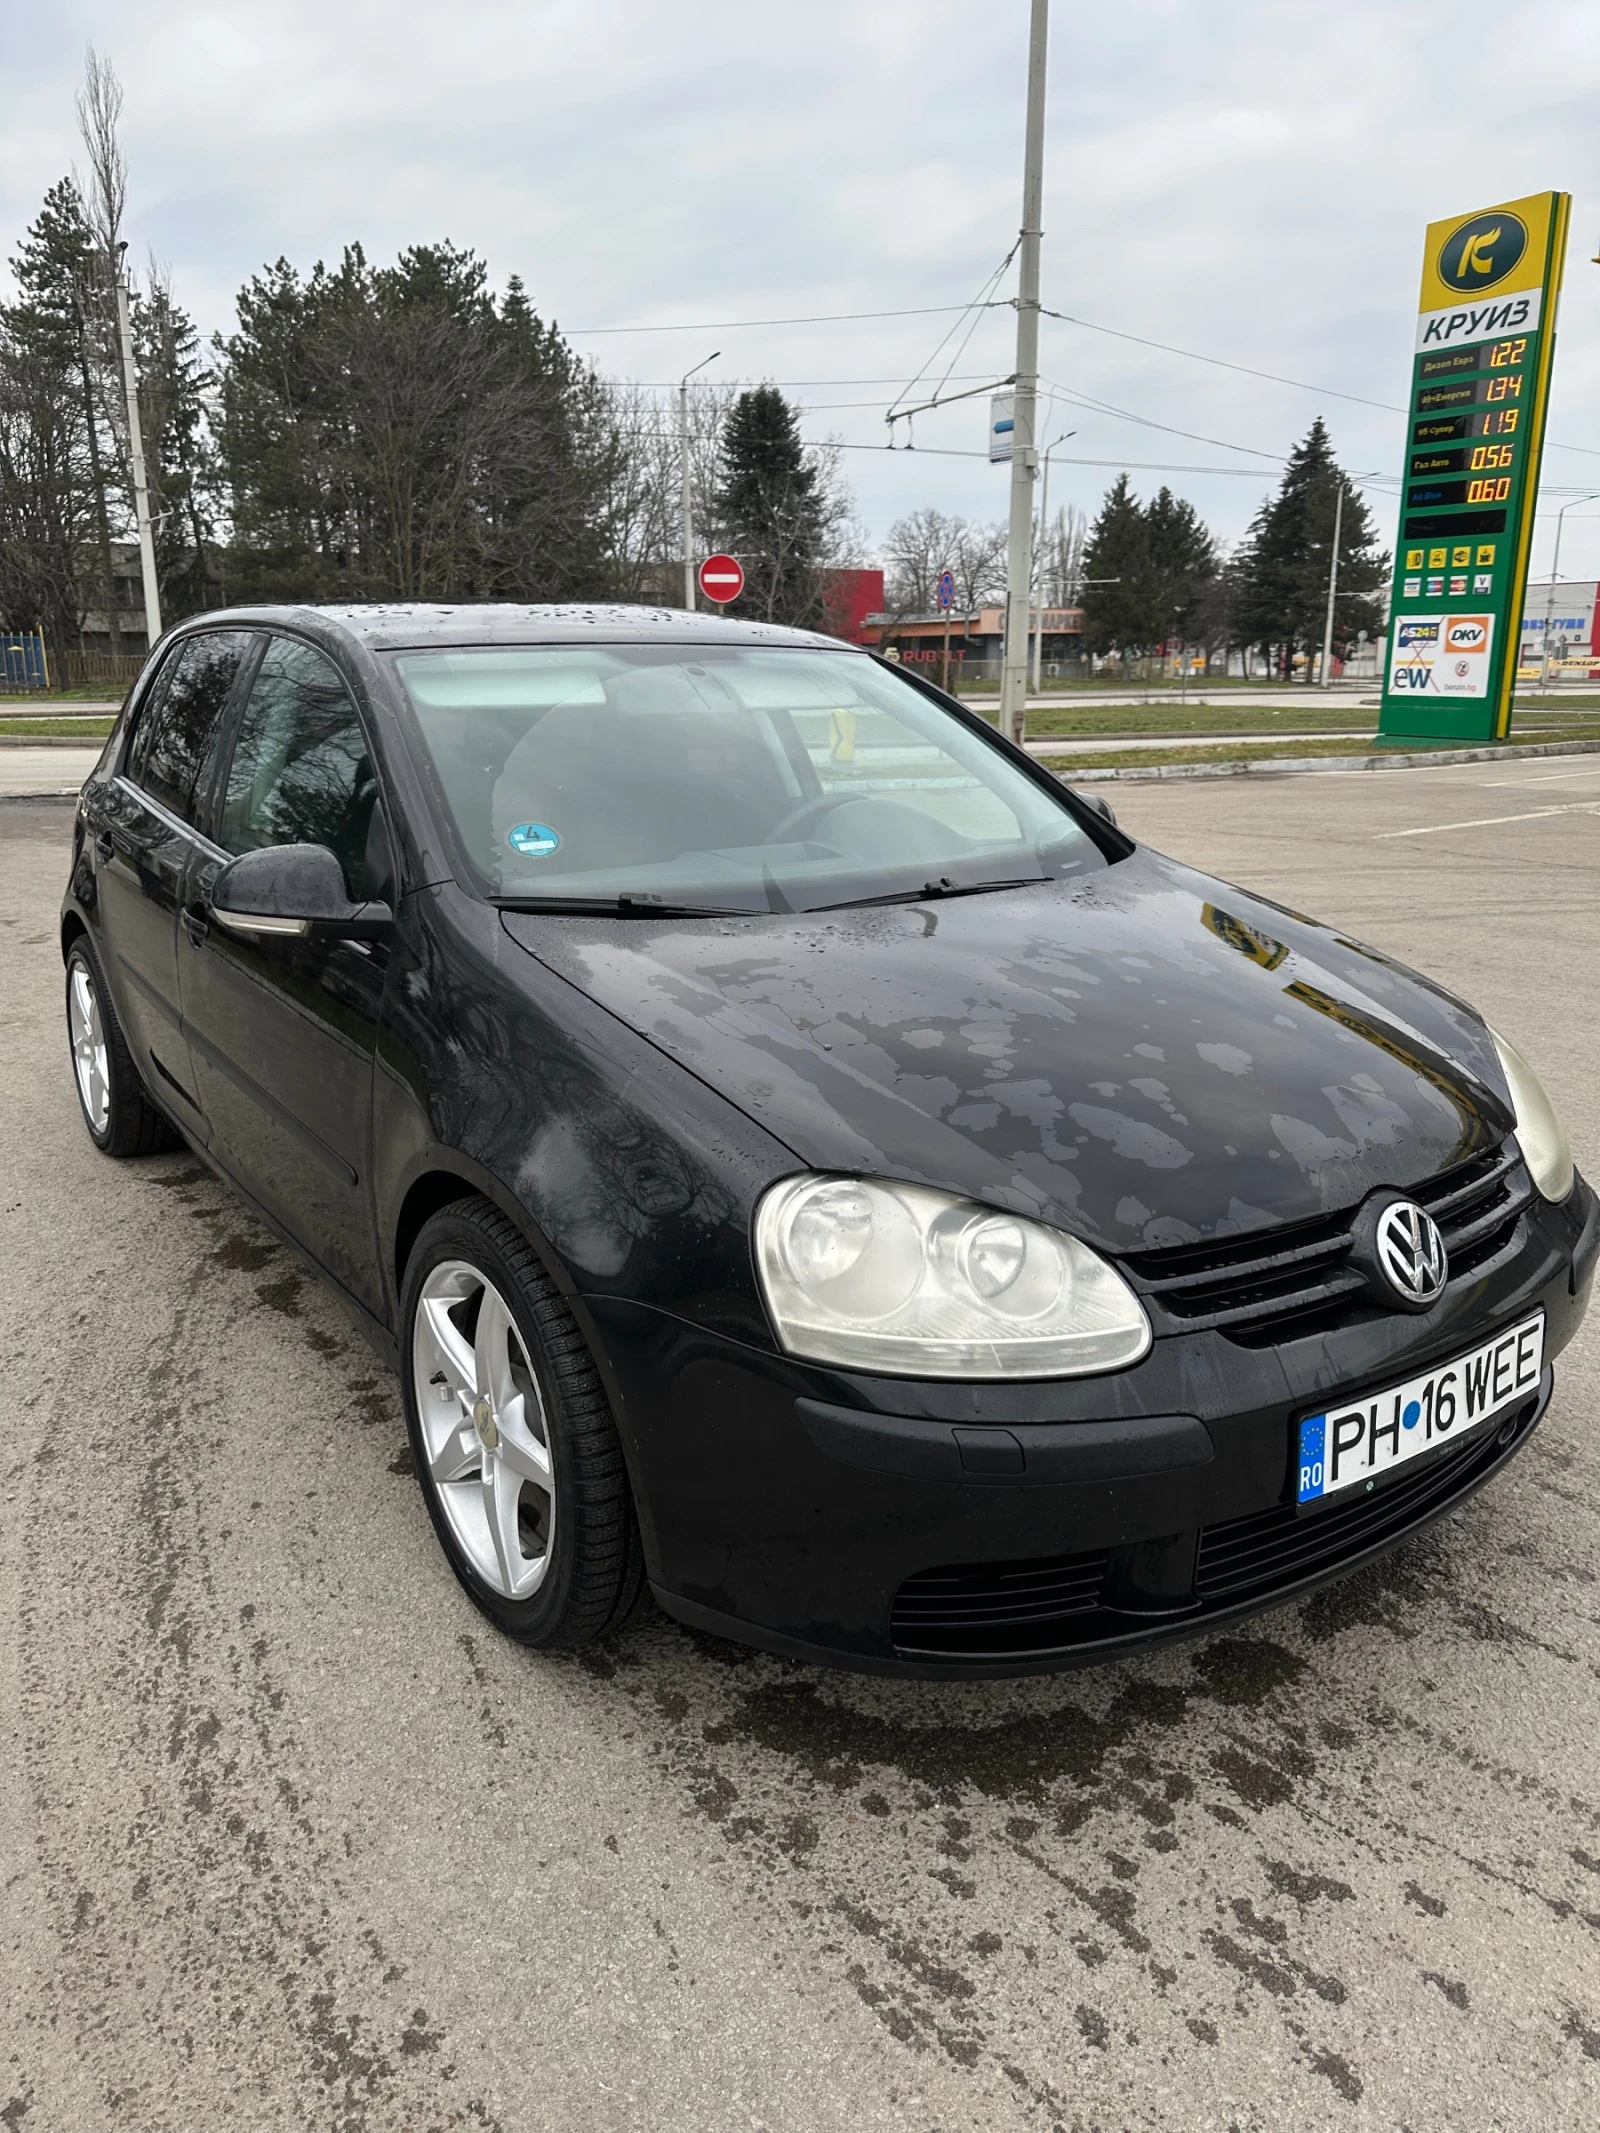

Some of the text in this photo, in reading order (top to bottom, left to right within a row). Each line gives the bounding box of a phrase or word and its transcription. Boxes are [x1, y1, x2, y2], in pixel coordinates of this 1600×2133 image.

[1422, 299, 1531, 344] КРУИЗ
[1453, 356, 1474, 367] Евро
[1429, 425, 1455, 436] Супер
[1414, 458, 1450, 470] Газ Авто
[1479, 577, 1487, 586] V
[1552, 618, 1586, 630] ГУМИ
[1400, 626, 1430, 638] AS24
[1451, 629, 1483, 641] DKV
[1394, 667, 1432, 689] ew
[1444, 683, 1477, 692] benzin.bg
[526, 825, 541, 840] 4
[1331, 1394, 1402, 1482] PH
[1421, 1371, 1458, 1440] 16
[1465, 1322, 1540, 1419] WEE
[1300, 1461, 1322, 1492] RO
